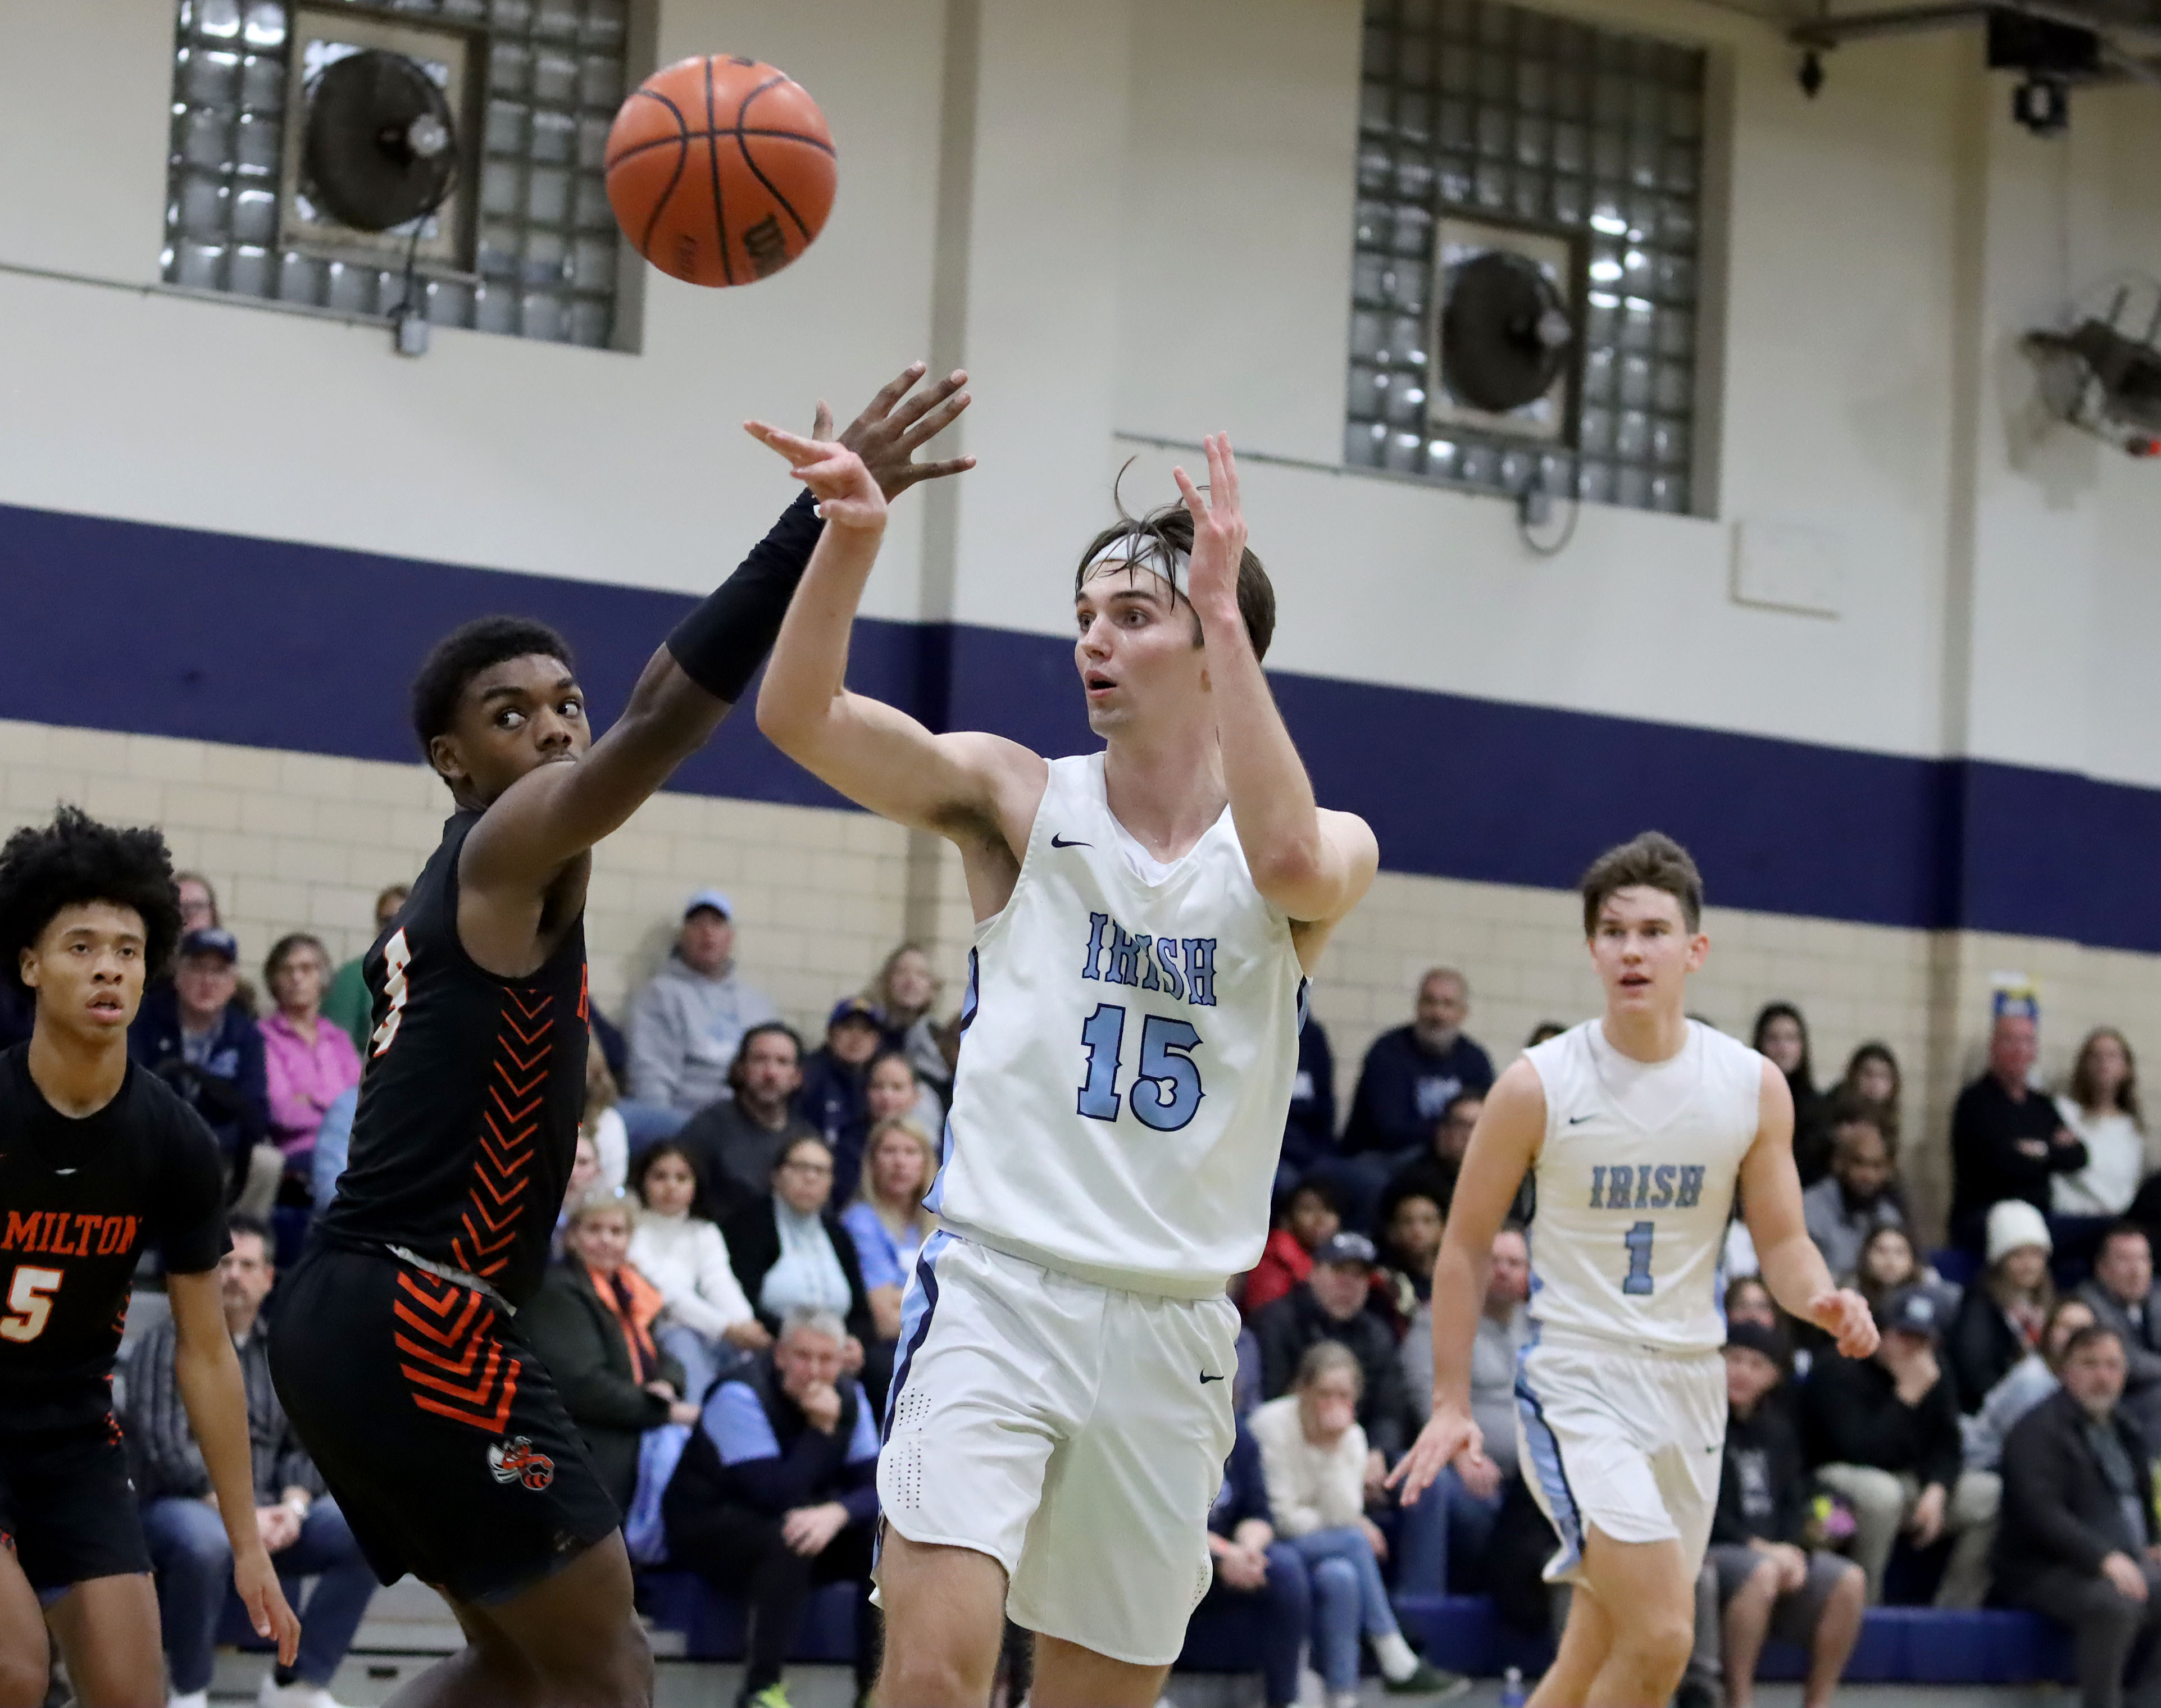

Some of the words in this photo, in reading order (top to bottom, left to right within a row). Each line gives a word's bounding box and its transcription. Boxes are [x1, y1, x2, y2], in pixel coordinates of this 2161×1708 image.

[1082, 912, 1217, 1006] IRISH
[1077, 1003, 1206, 1132] 15
[1590, 1165, 1705, 1208] IRISH
[1623, 1221, 1654, 1295] 1
[0, 1264, 64, 1343] 5
